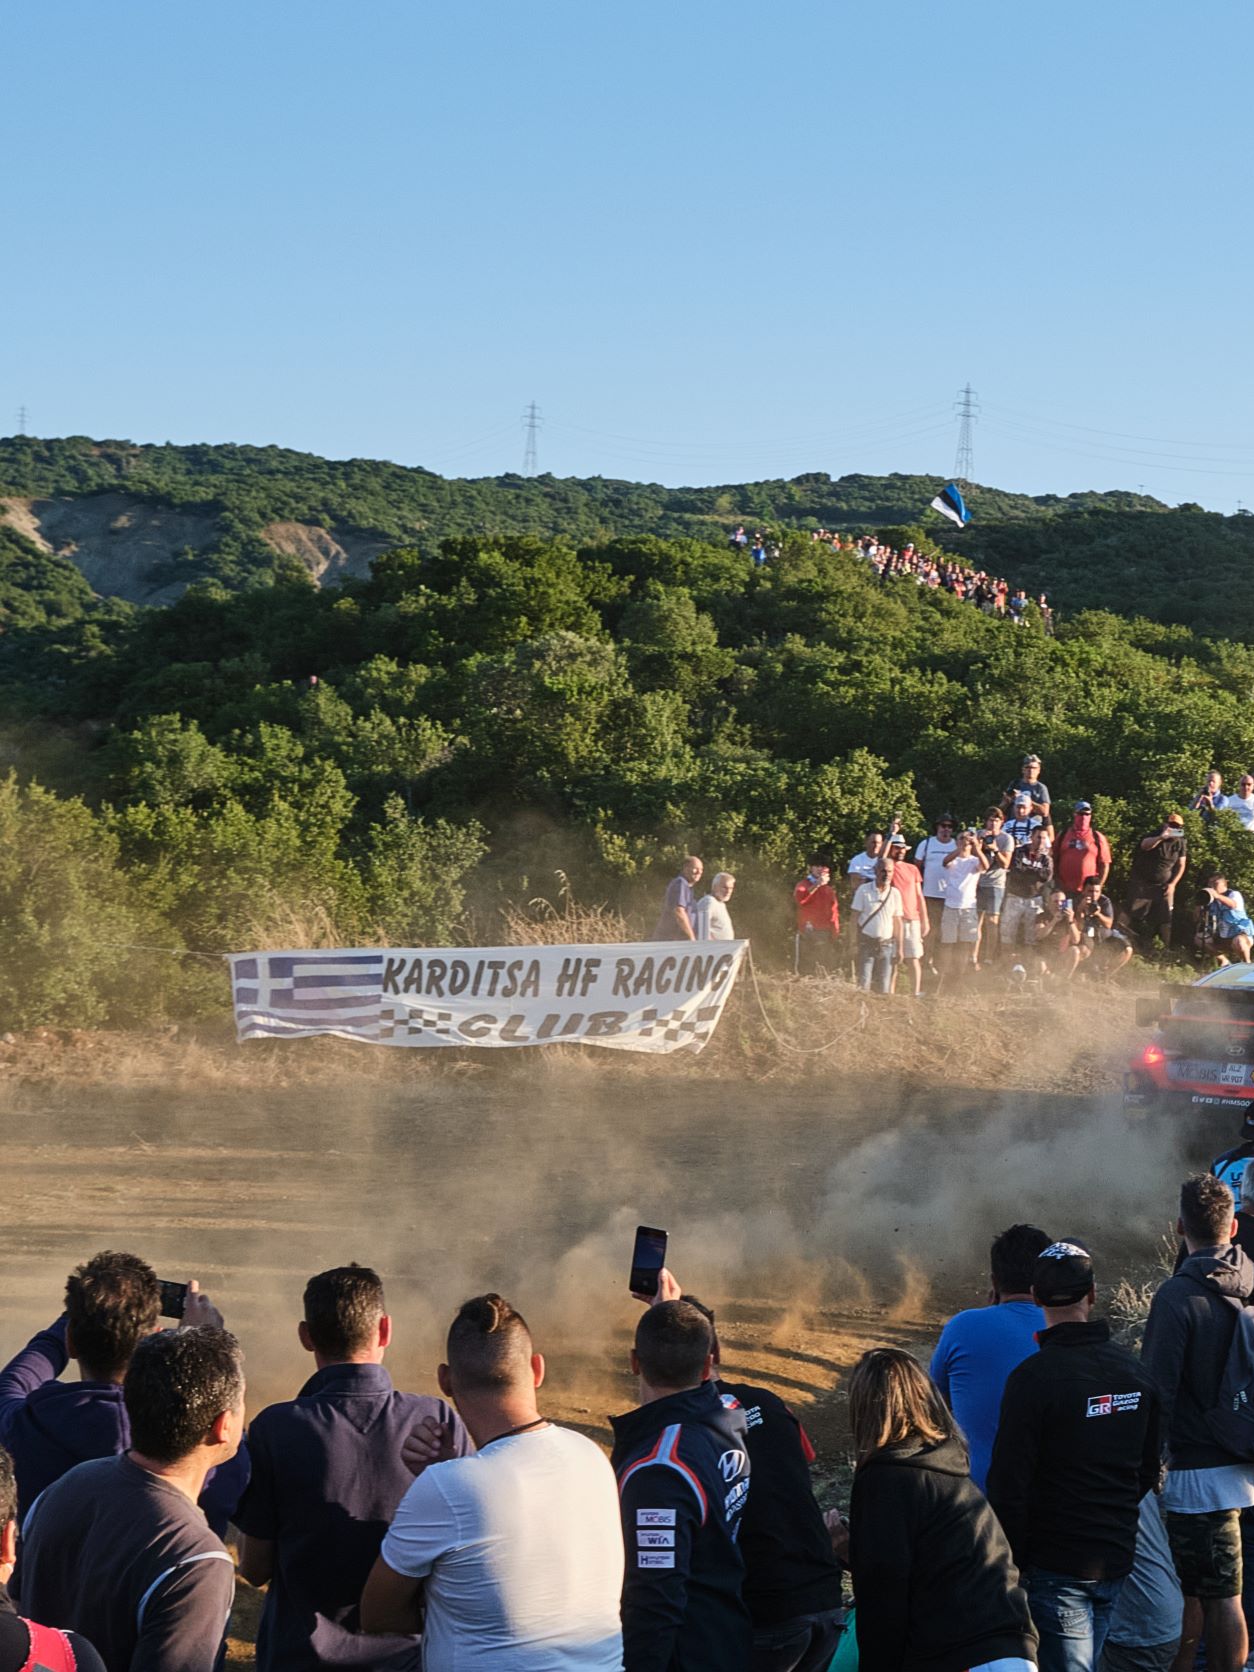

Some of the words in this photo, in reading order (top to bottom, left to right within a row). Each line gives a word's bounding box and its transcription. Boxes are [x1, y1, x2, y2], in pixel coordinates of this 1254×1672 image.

[383, 958, 541, 998] KARDITSA
[556, 957, 602, 997] HF
[612, 954, 733, 999] RACING
[458, 1011, 629, 1042] CLUB
[1088, 1403, 1111, 1415] GR
[1112, 1391, 1142, 1400] TOYOTA
[1112, 1398, 1140, 1406] GAZOO
